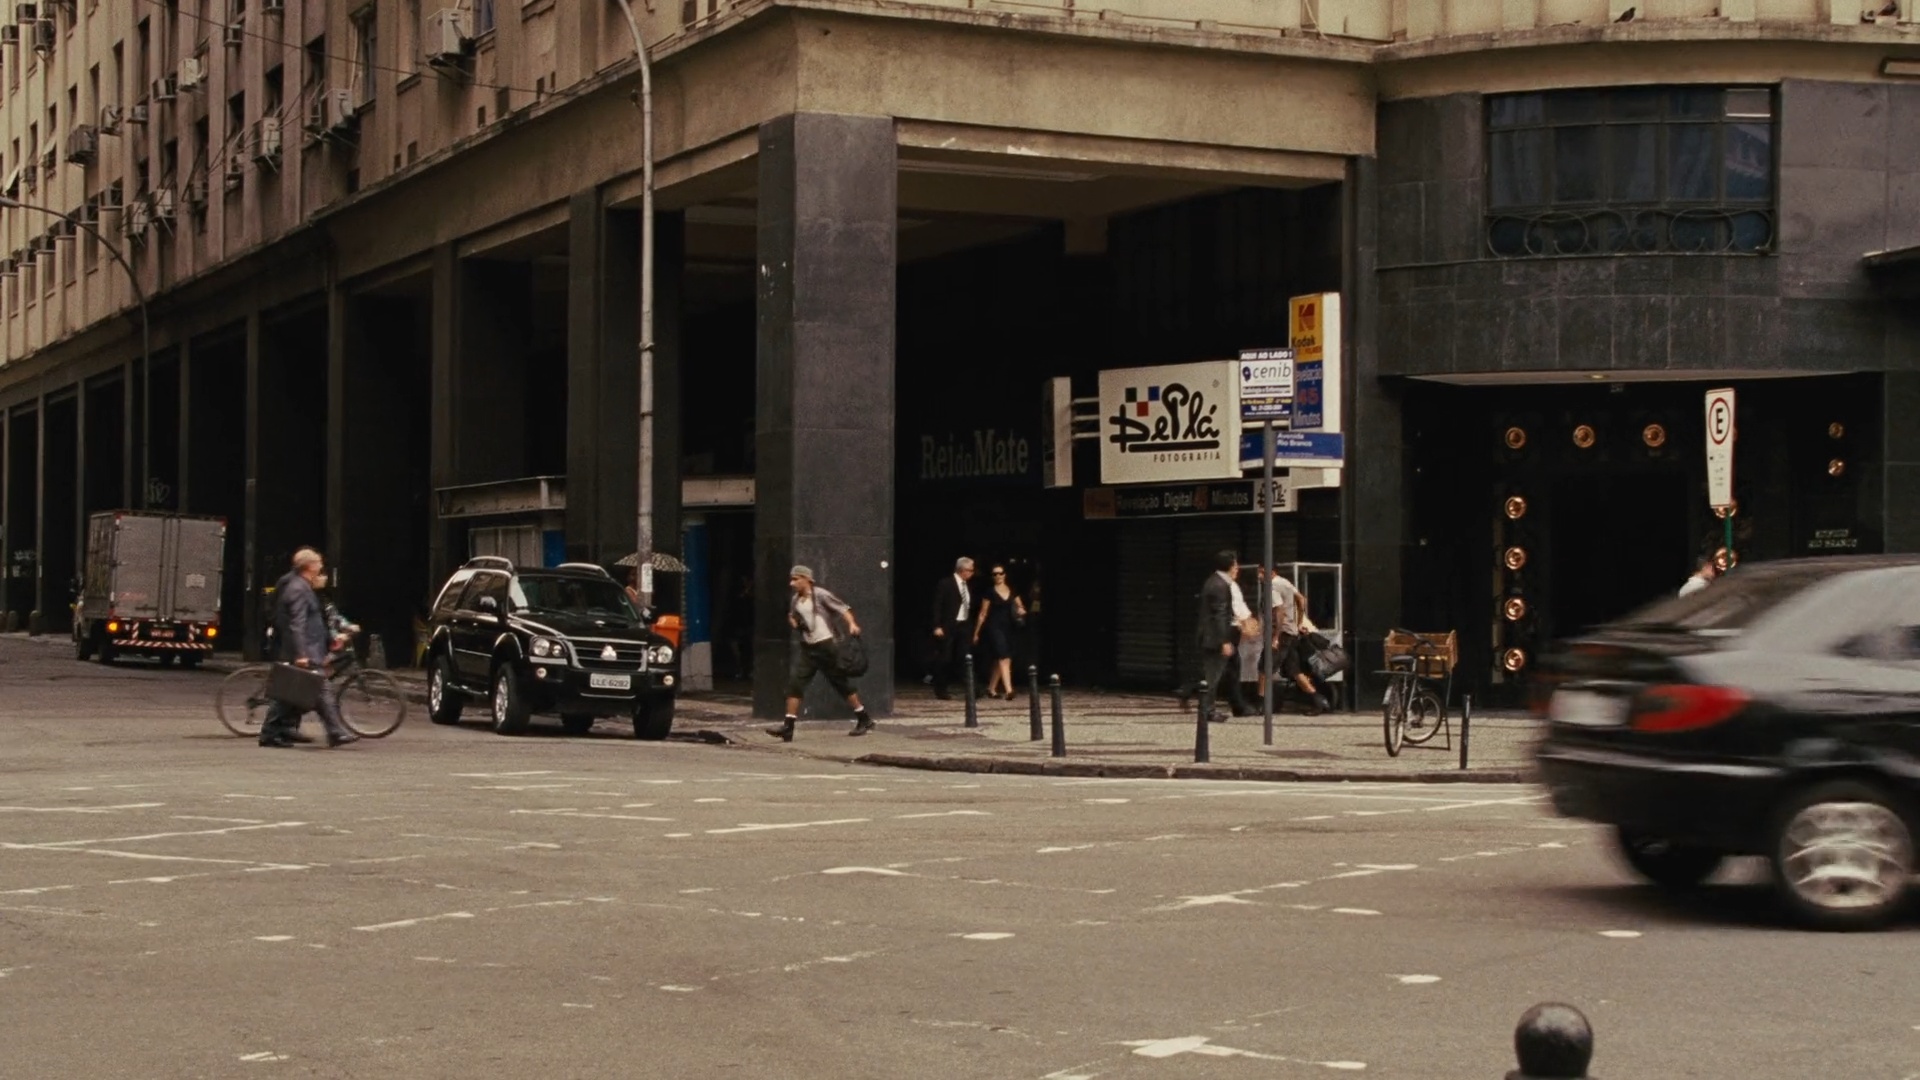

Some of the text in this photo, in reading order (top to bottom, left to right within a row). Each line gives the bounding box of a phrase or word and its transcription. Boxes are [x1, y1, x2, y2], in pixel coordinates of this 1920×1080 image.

[1291, 335, 1316, 348] Kodak
[1253, 362, 1291, 379] cenib
[1296, 364, 1322, 384] evelação
[1298, 388, 1320, 406] 45
[1716, 408, 1723, 434] E
[1153, 451, 1221, 463] FOTOGRAFIA
[1164, 491, 1193, 511] Digital
[1212, 490, 1249, 505] Minutos
